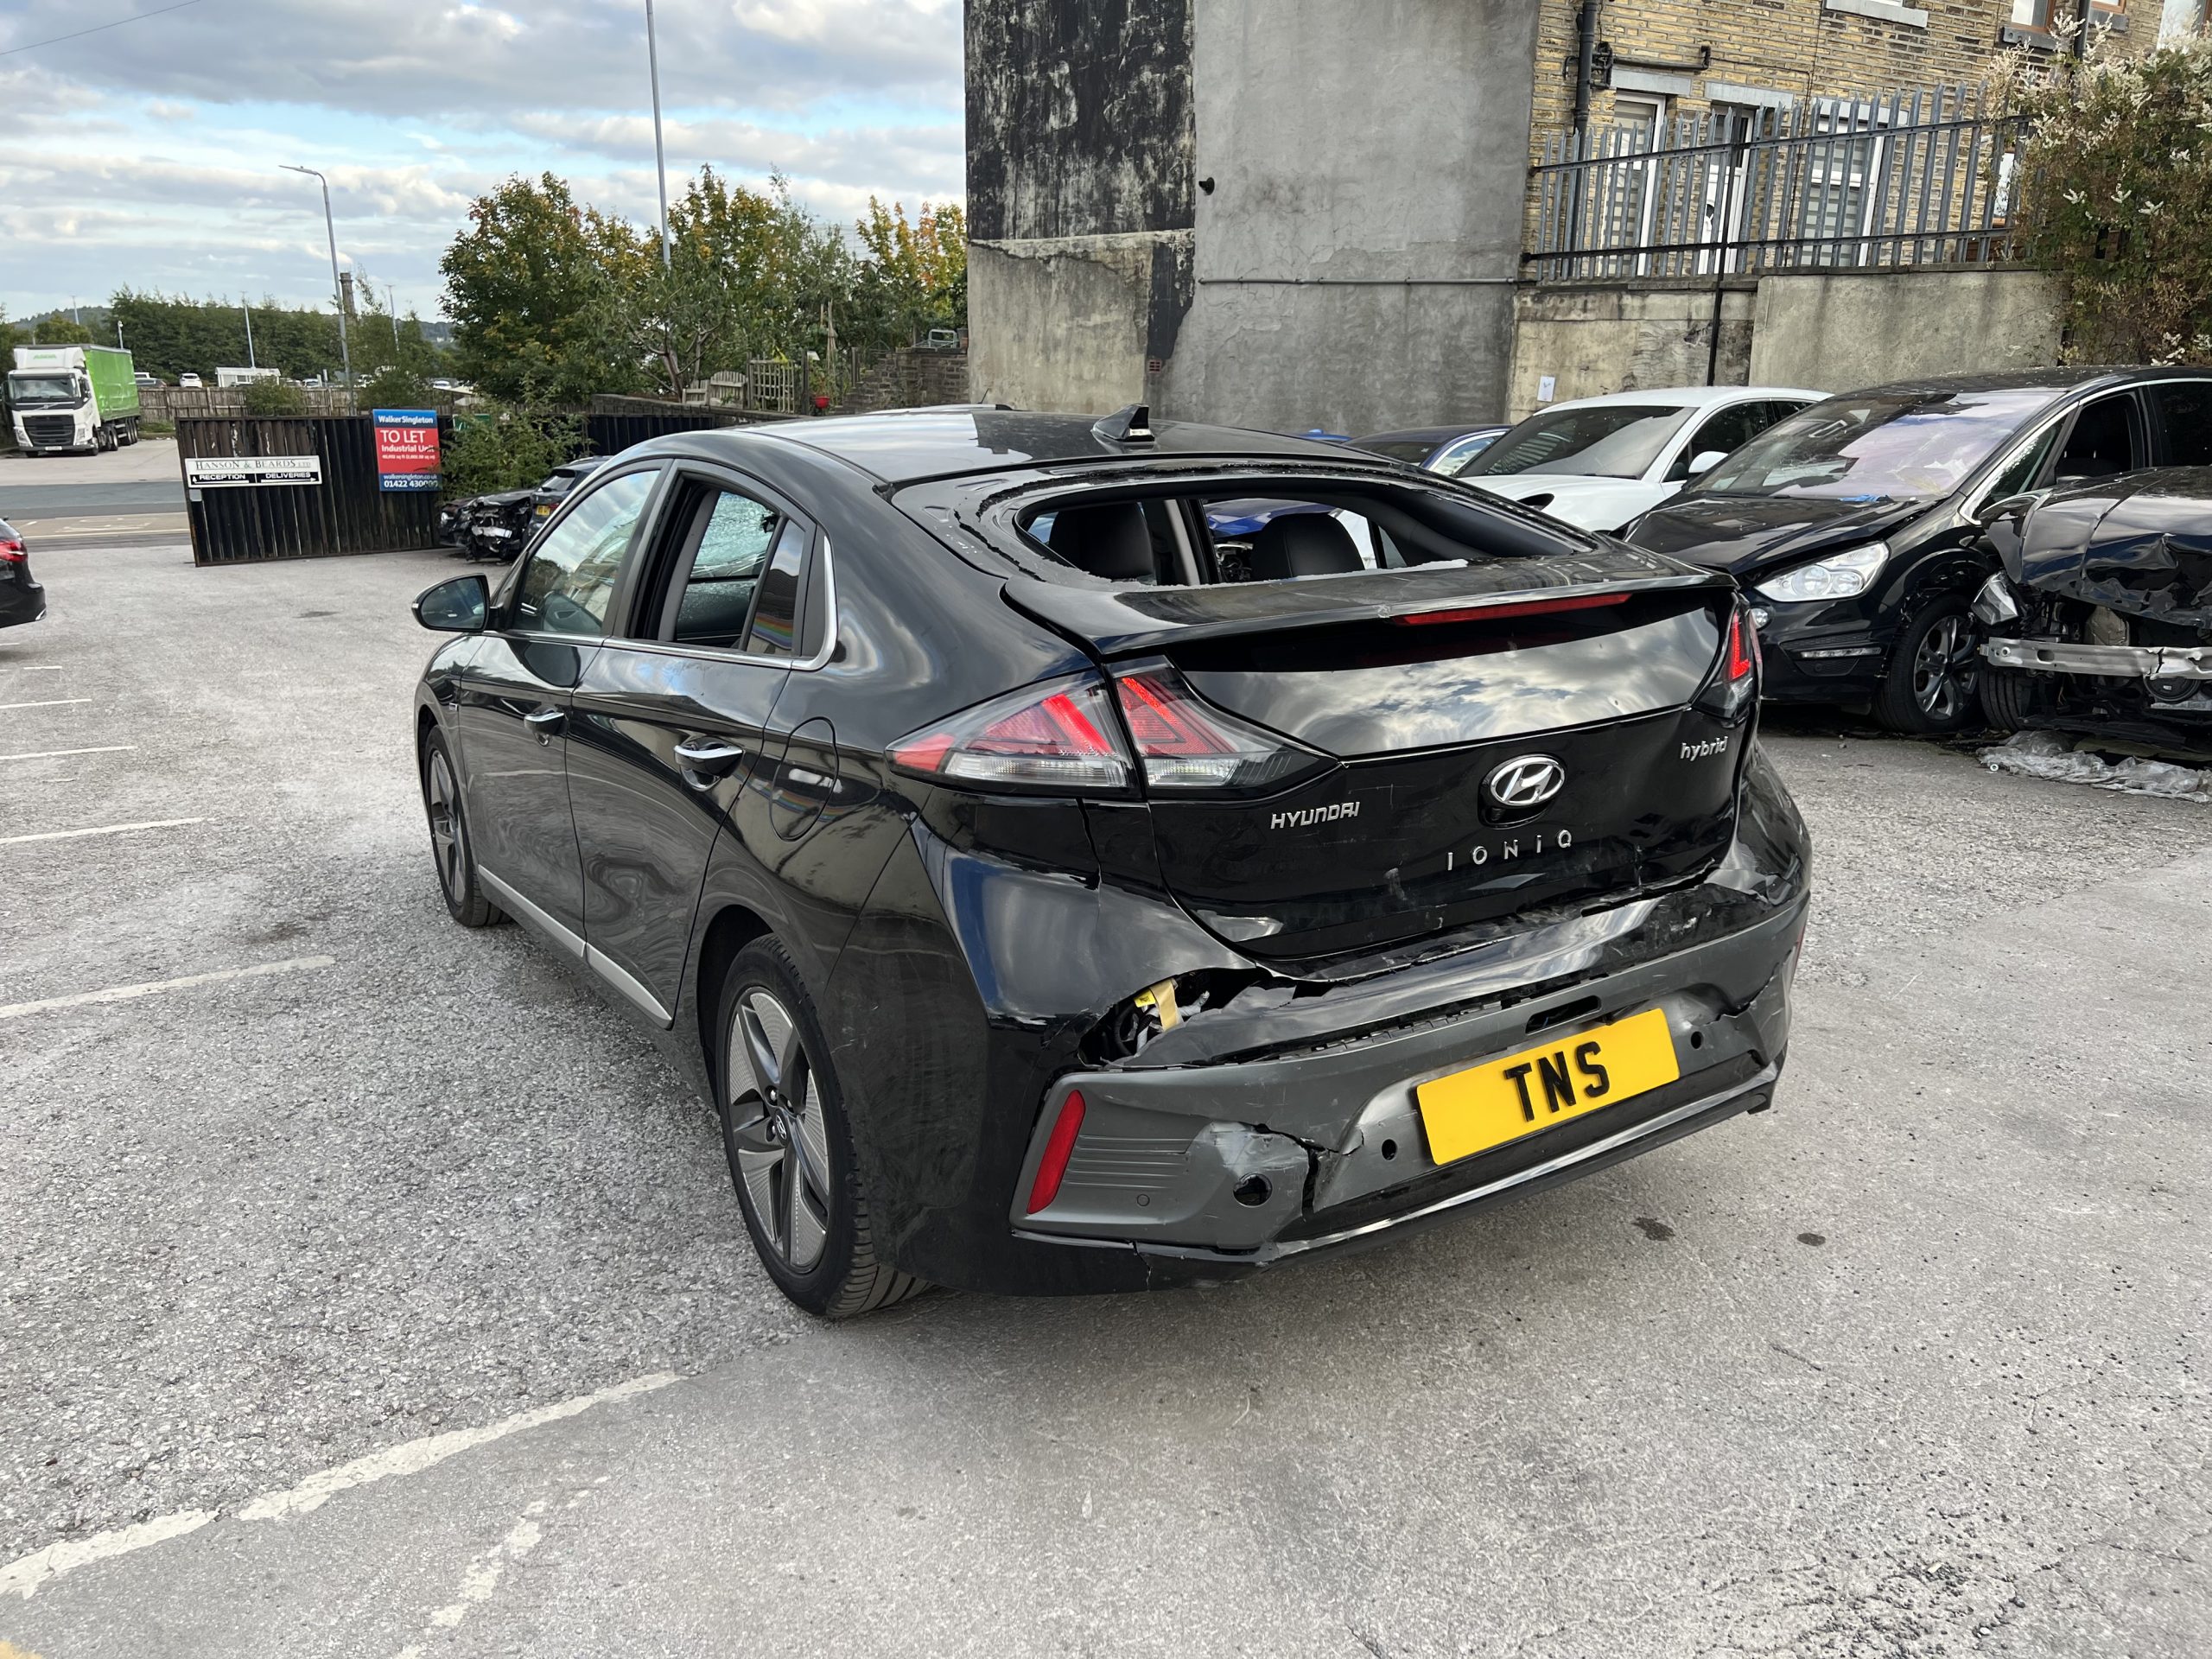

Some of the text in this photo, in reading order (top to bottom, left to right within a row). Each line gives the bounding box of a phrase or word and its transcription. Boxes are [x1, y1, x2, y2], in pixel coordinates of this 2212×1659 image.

[380, 430, 426, 443] TO LET
[195, 461, 239, 470] HANSON
[255, 460, 296, 469] BEARDS
[1679, 735, 1729, 761] hybrid
[1269, 800, 1361, 830] HYUNDAI
[1446, 830, 1573, 871] IONIQ
[1503, 1040, 1611, 1122] TNS
